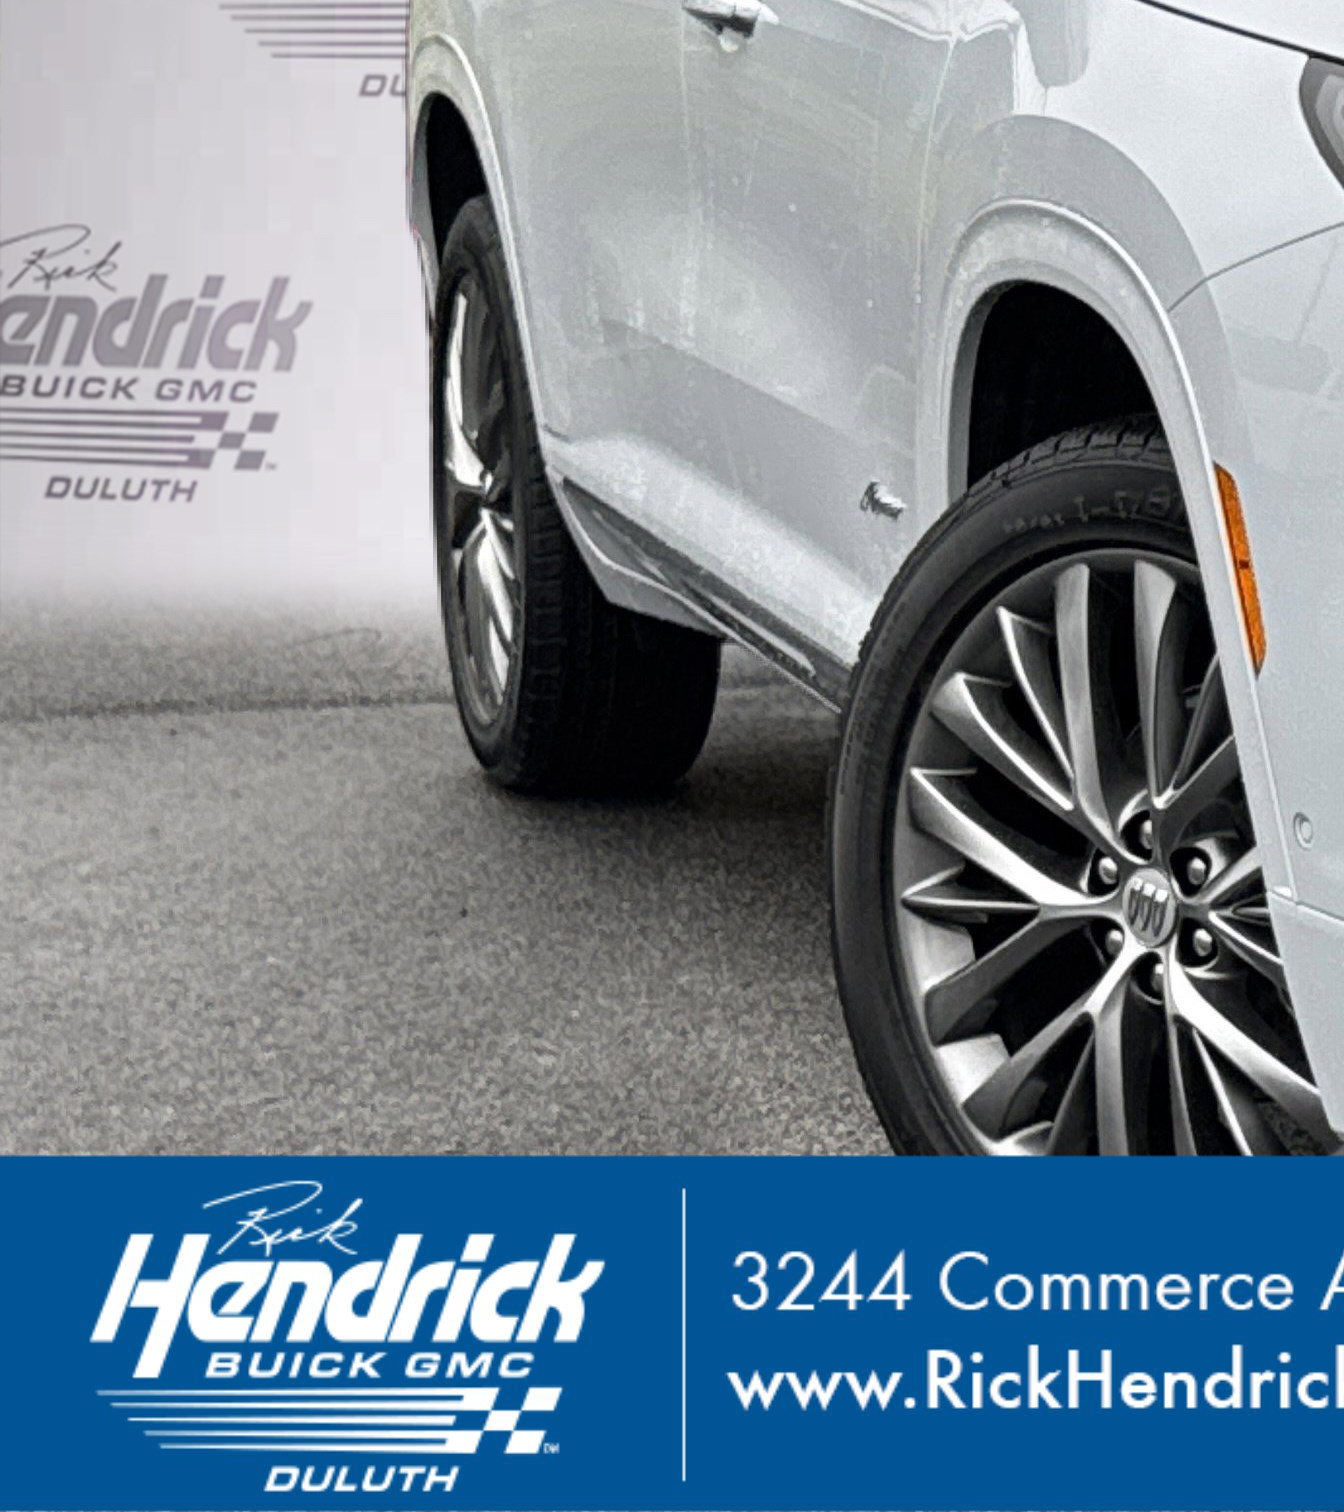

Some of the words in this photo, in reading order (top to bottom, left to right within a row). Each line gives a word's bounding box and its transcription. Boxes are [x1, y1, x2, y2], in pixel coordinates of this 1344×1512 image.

[0, 273, 313, 372] endrick
[0, 373, 140, 401] BUICK
[154, 377, 257, 404] GMC
[44, 475, 198, 503] DULUTH
